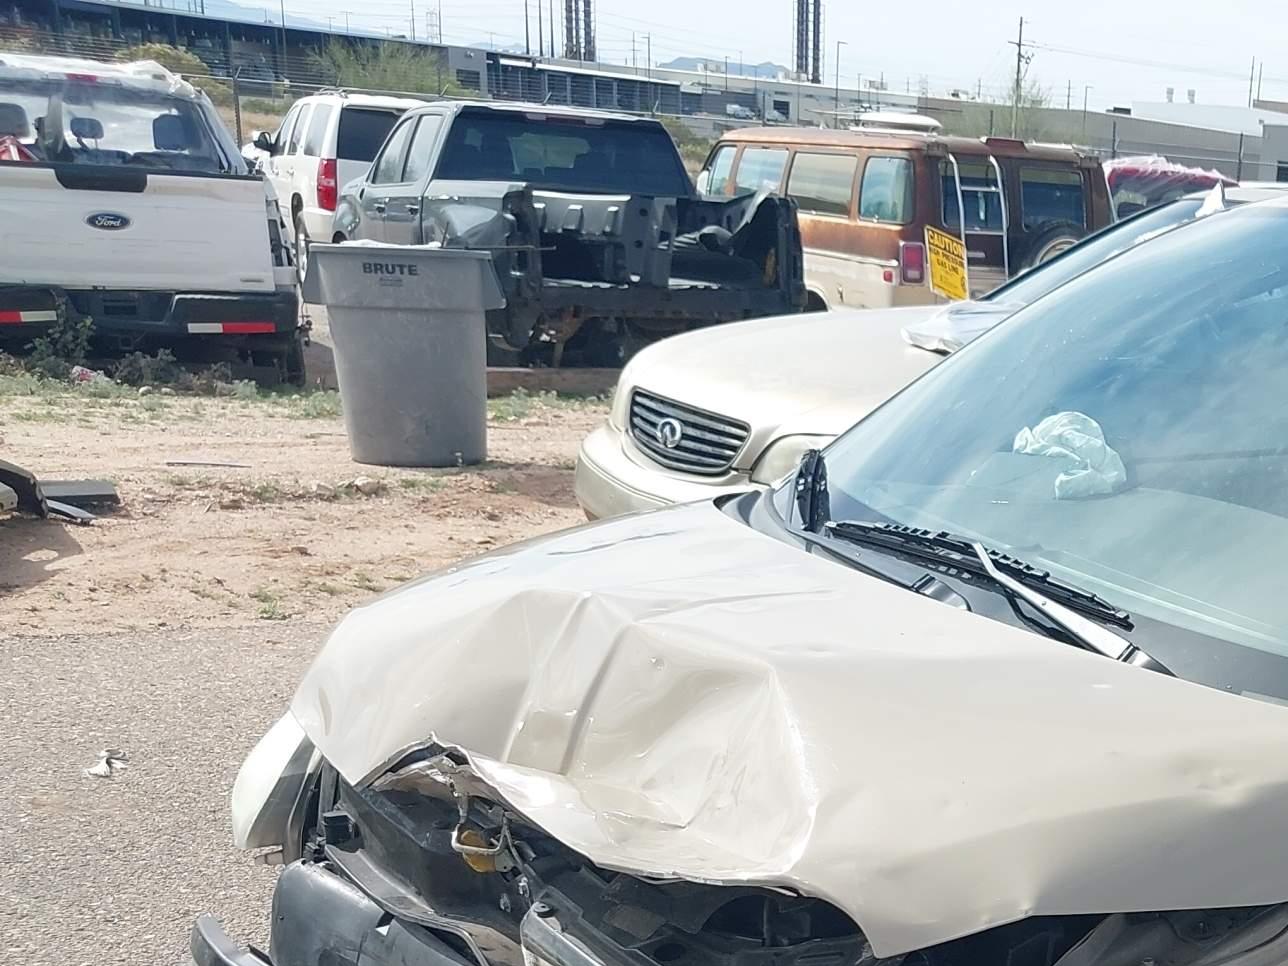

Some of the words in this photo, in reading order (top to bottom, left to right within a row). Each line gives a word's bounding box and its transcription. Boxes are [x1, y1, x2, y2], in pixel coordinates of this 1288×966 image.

[95, 214, 122, 227] Ford
[928, 230, 964, 259] CAUTION
[362, 262, 419, 276] BRUTE
